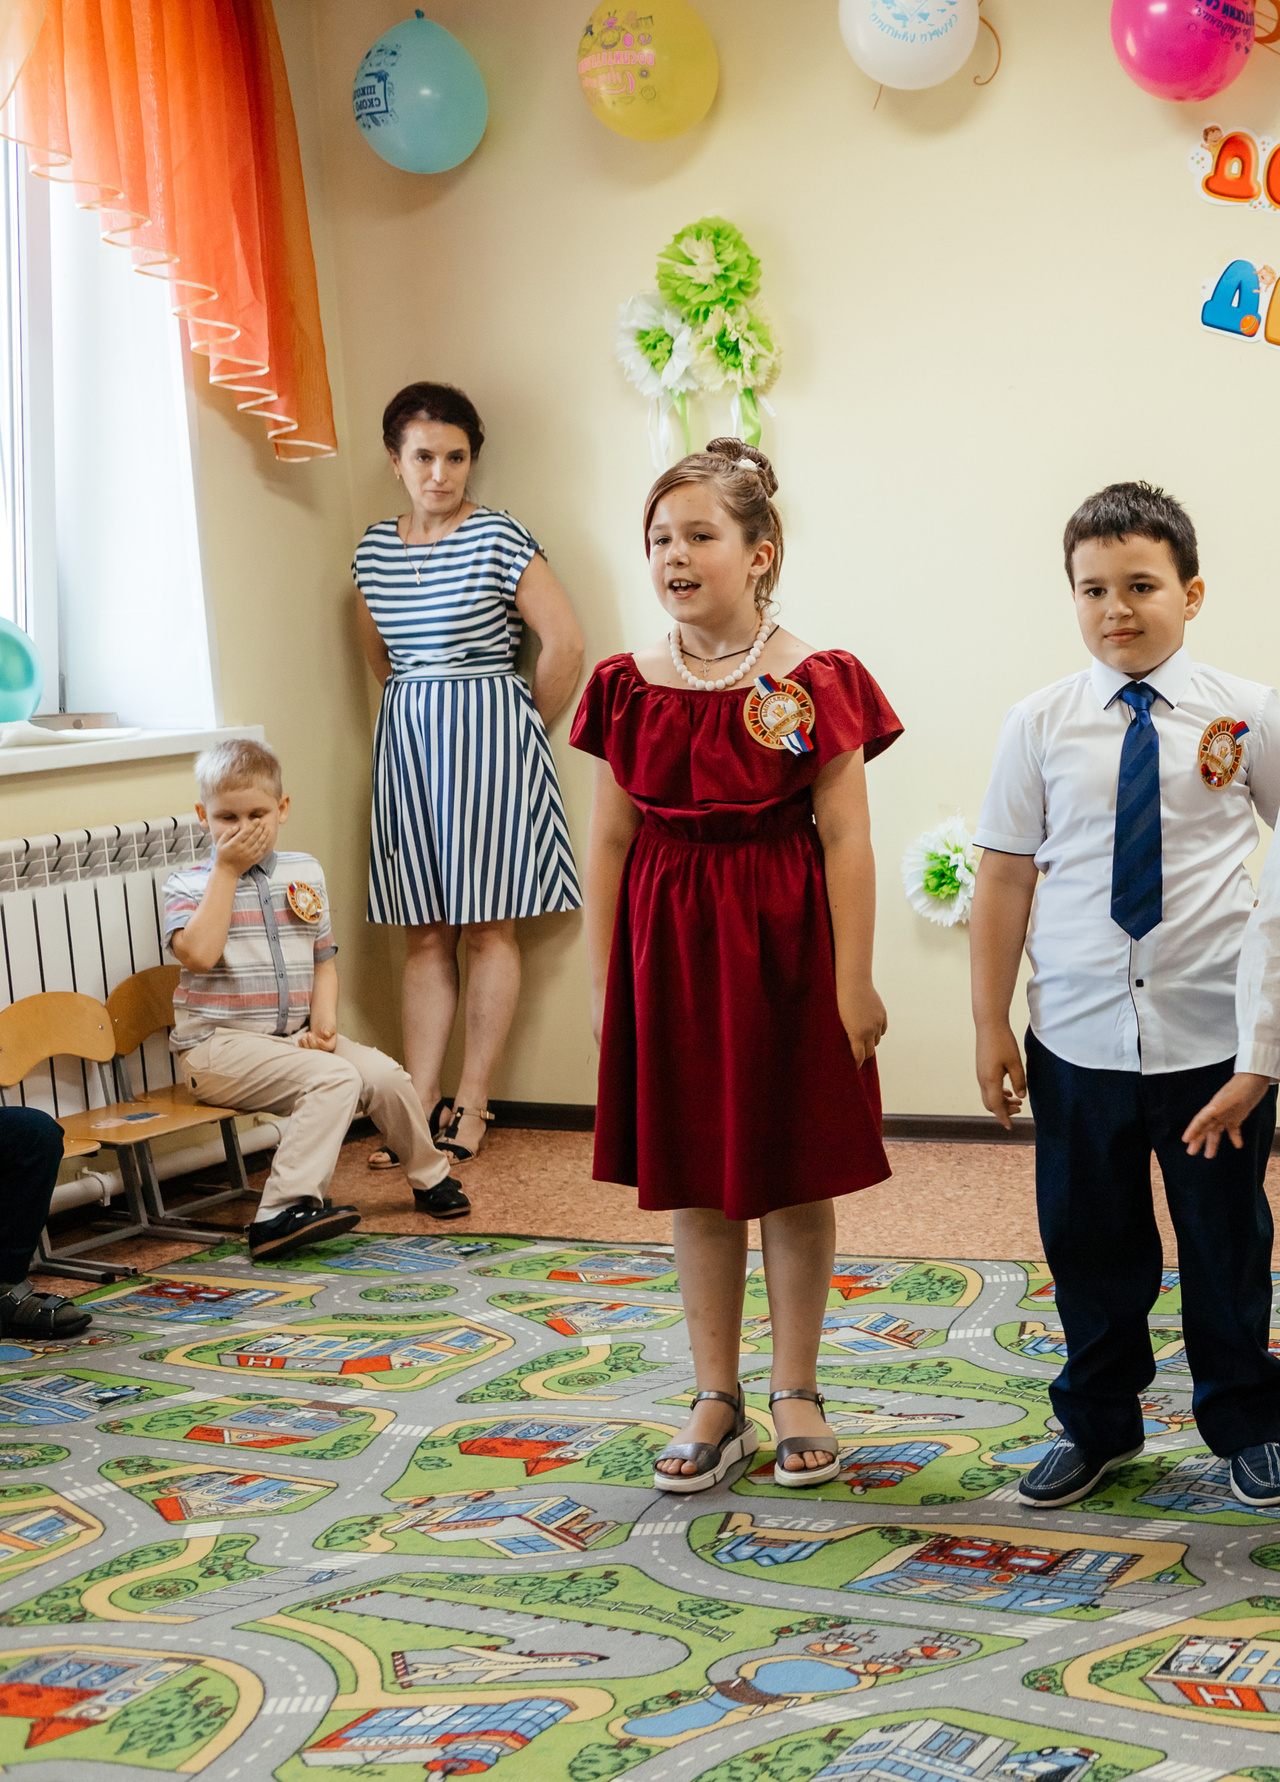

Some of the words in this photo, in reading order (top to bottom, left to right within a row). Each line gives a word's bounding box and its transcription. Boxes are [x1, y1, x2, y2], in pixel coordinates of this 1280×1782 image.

[248, 1357, 274, 1367] H
[759, 1519, 835, 1532] BUS
[1202, 1687, 1242, 1708] H
[347, 1735, 437, 1748] AIRPORT
